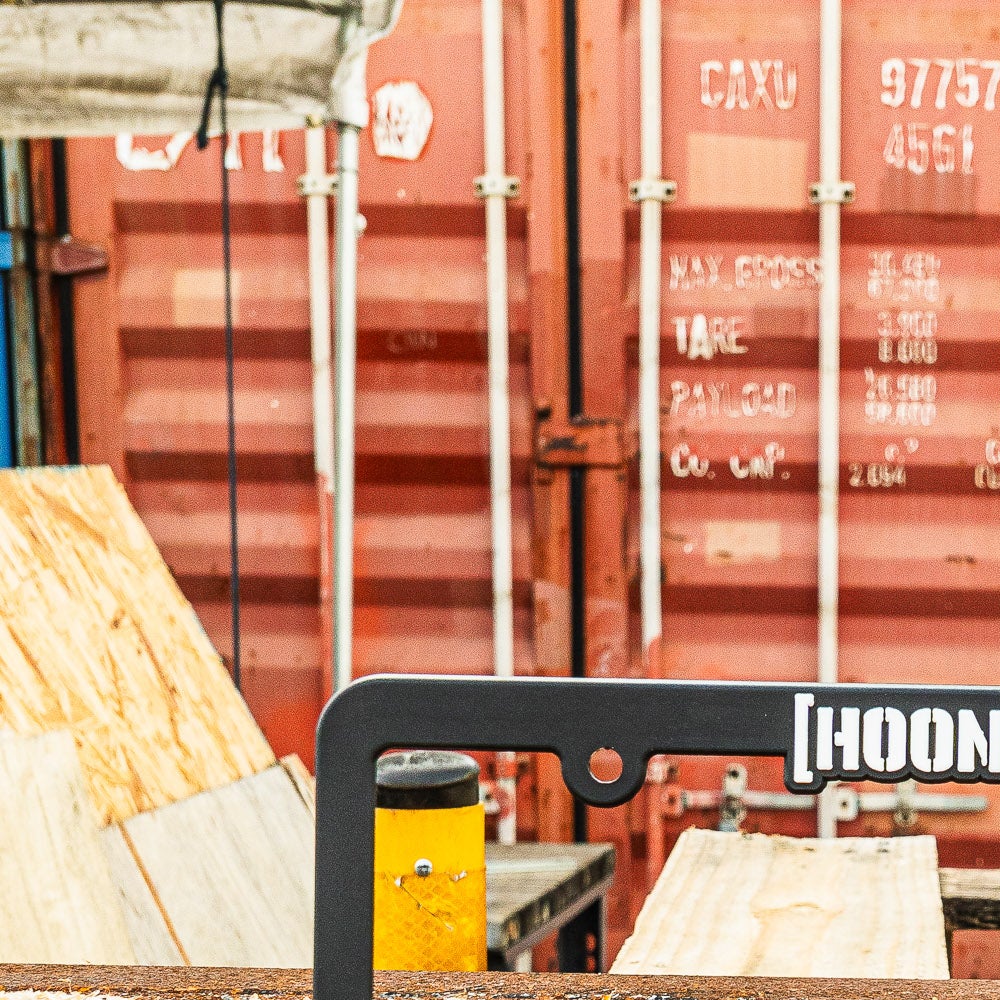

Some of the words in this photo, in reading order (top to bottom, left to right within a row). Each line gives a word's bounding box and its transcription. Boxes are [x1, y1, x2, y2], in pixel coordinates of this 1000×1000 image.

[701, 59, 798, 110] CAXU
[671, 313, 749, 361] TARE
[669, 380, 798, 419] PAYLOAD
